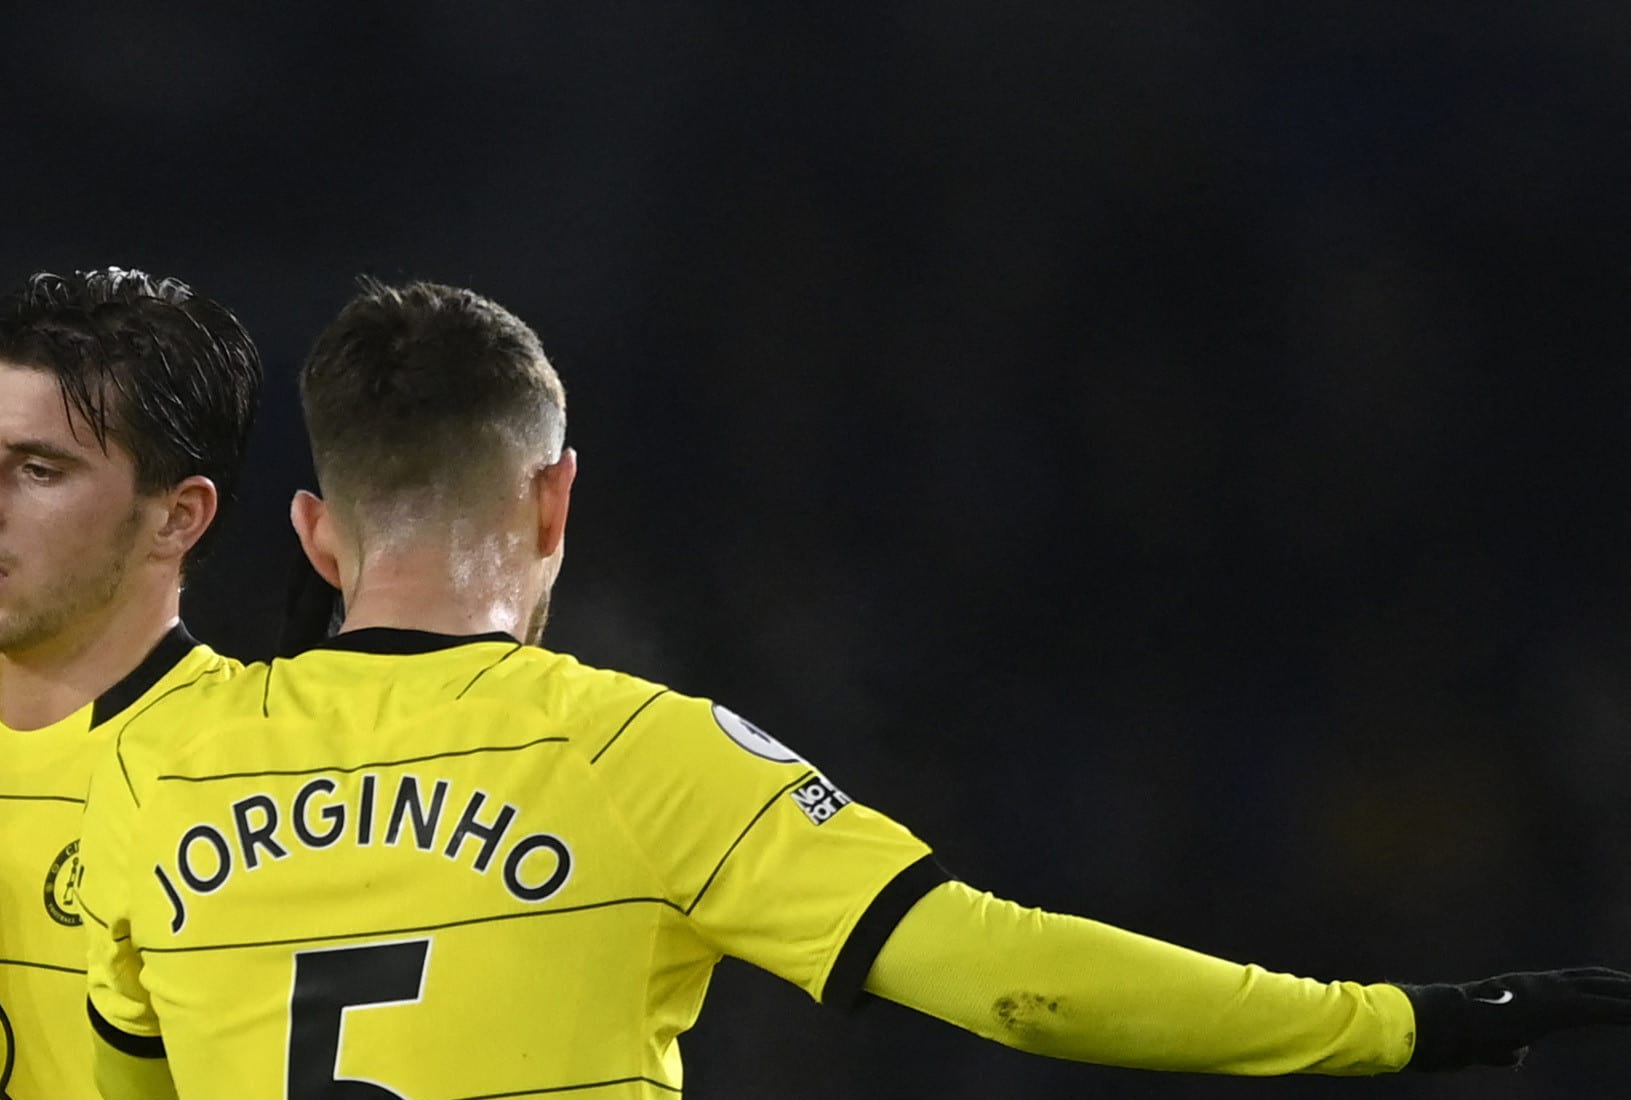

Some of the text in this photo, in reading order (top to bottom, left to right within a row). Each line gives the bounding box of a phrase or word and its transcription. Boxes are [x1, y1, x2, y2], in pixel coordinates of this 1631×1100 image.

[790, 784, 825, 809] No
[804, 796, 837, 826] for
[153, 774, 574, 934] JORGINHO
